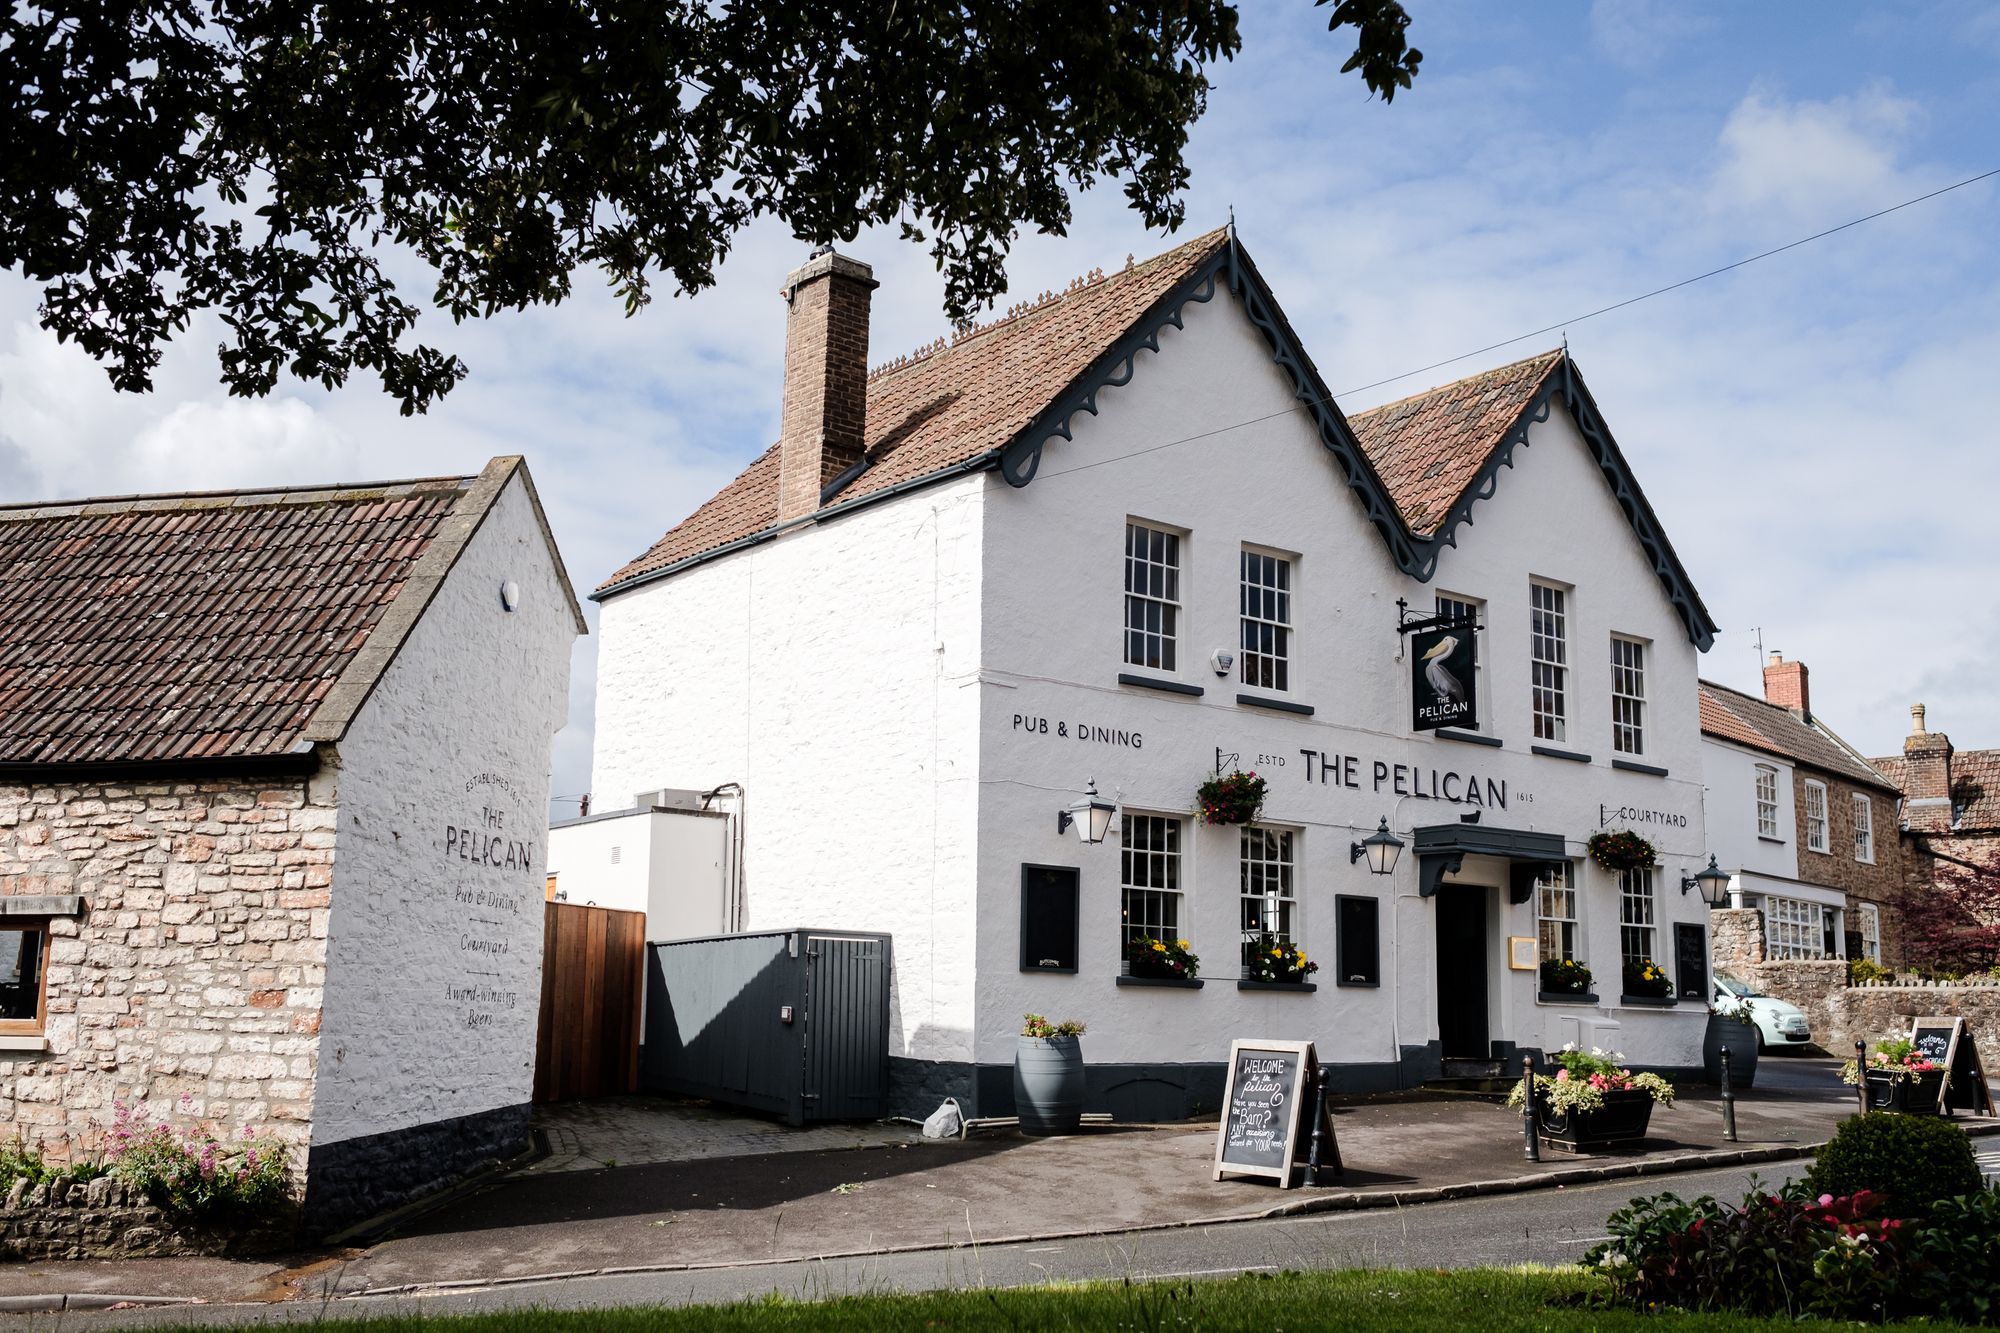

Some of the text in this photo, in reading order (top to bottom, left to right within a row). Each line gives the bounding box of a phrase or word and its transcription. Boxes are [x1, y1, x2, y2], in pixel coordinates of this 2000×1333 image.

[1419, 701, 1468, 718] PELICAN
[1437, 696, 1450, 704] THE
[1013, 714, 1142, 748] PUB & DINING
[465, 773, 509, 793] ESTABLSHED
[1258, 749, 1534, 810] ESTD THE PELICAN 1615
[482, 806, 505, 829] THE
[1620, 806, 1687, 828] COURTYARD
[446, 825, 533, 874] PELICAN
[455, 885, 473, 904] Pub
[488, 891, 520, 916] Dining
[461, 933, 508, 958] Courtyard
[445, 984, 517, 1009] Award-winning
[468, 1008, 493, 1027] Beers
[1244, 1060, 1285, 1074] WELCOME
[1232, 1107, 1240, 1115] the
[1233, 1098, 1247, 1107] Have
[1247, 1101, 1257, 1110] you
[1230, 1123, 1246, 1136] ANY
[1254, 1138, 1271, 1152] YOUR
